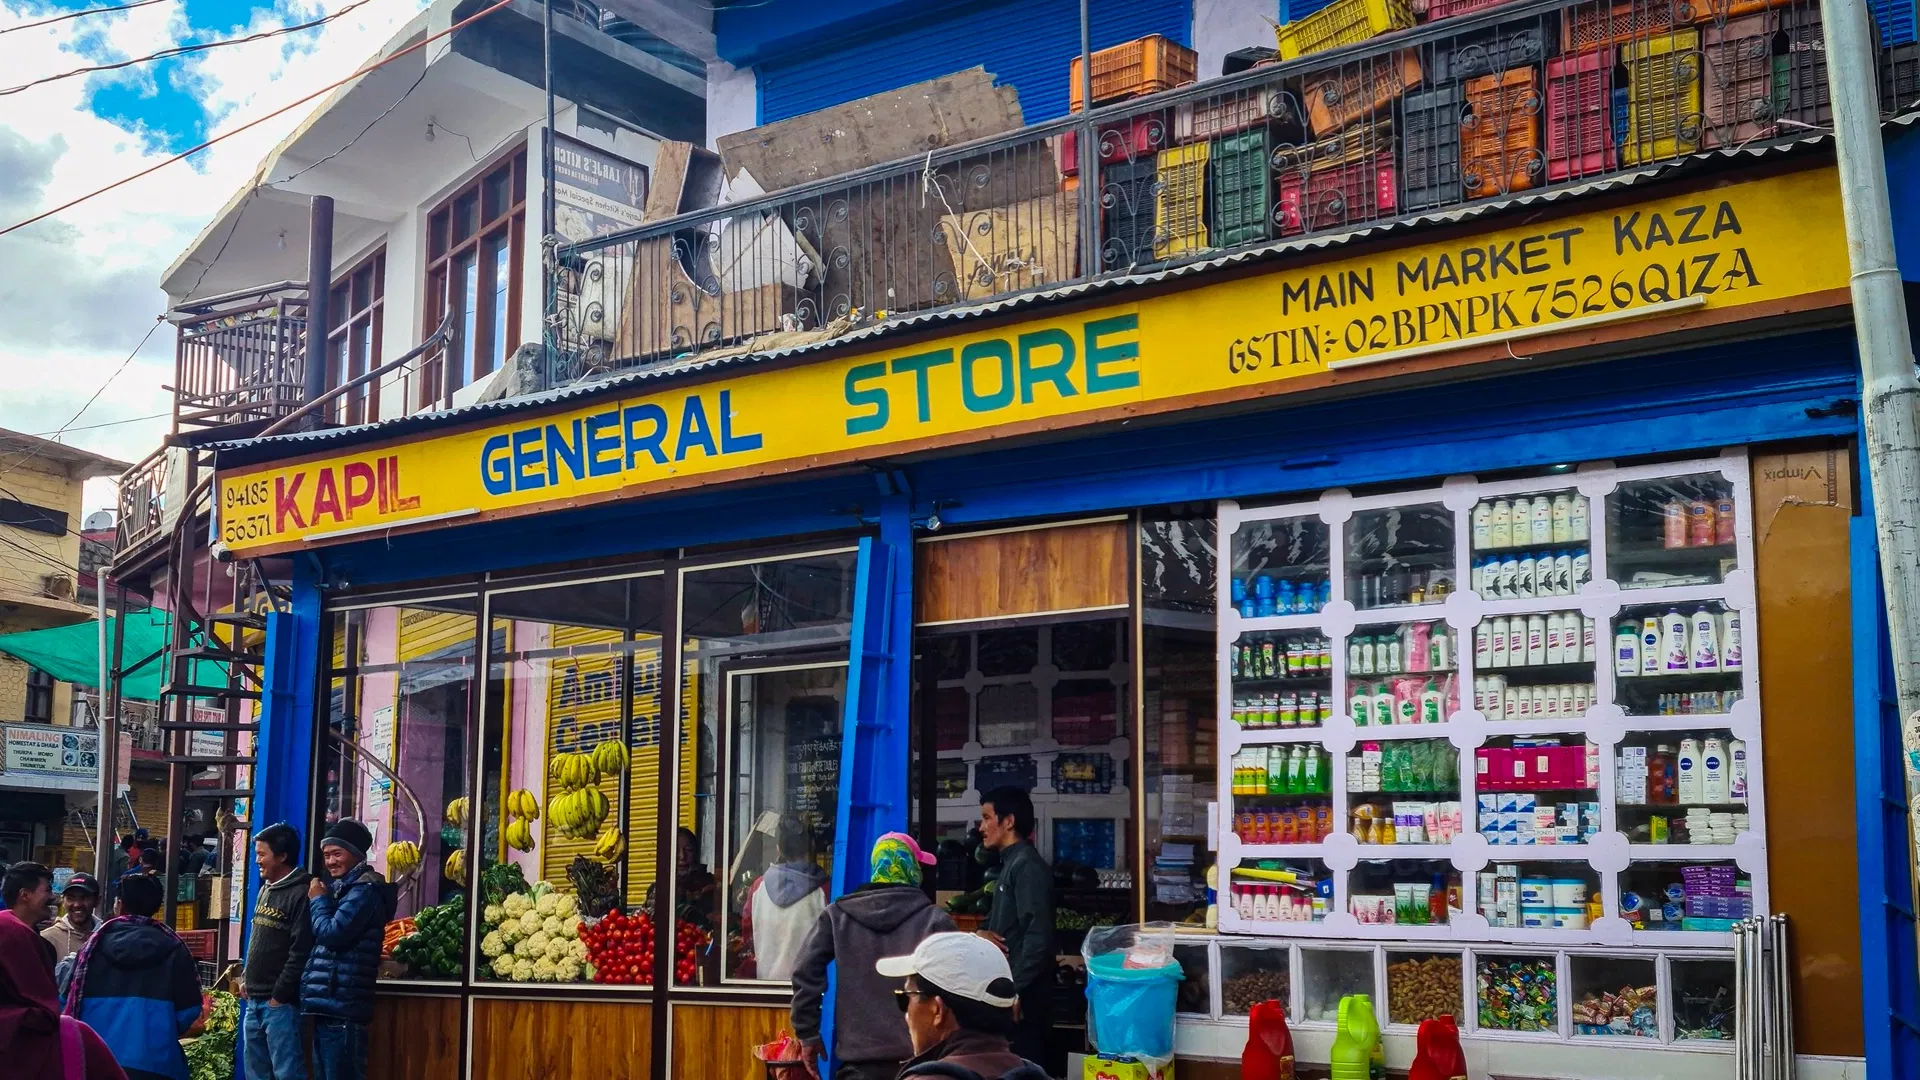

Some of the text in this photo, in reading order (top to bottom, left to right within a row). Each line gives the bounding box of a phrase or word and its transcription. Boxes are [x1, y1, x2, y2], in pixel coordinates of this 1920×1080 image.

[1282, 200, 1742, 316] MAIN MARKET KAZA
[274, 313, 1141, 534] KAPIL GENERAL STORE
[226, 480, 269, 509] 94185
[225, 514, 271, 543] 56371
[8, 729, 60, 742] NIMALING
[8, 740, 36, 748] HOMESTAY
